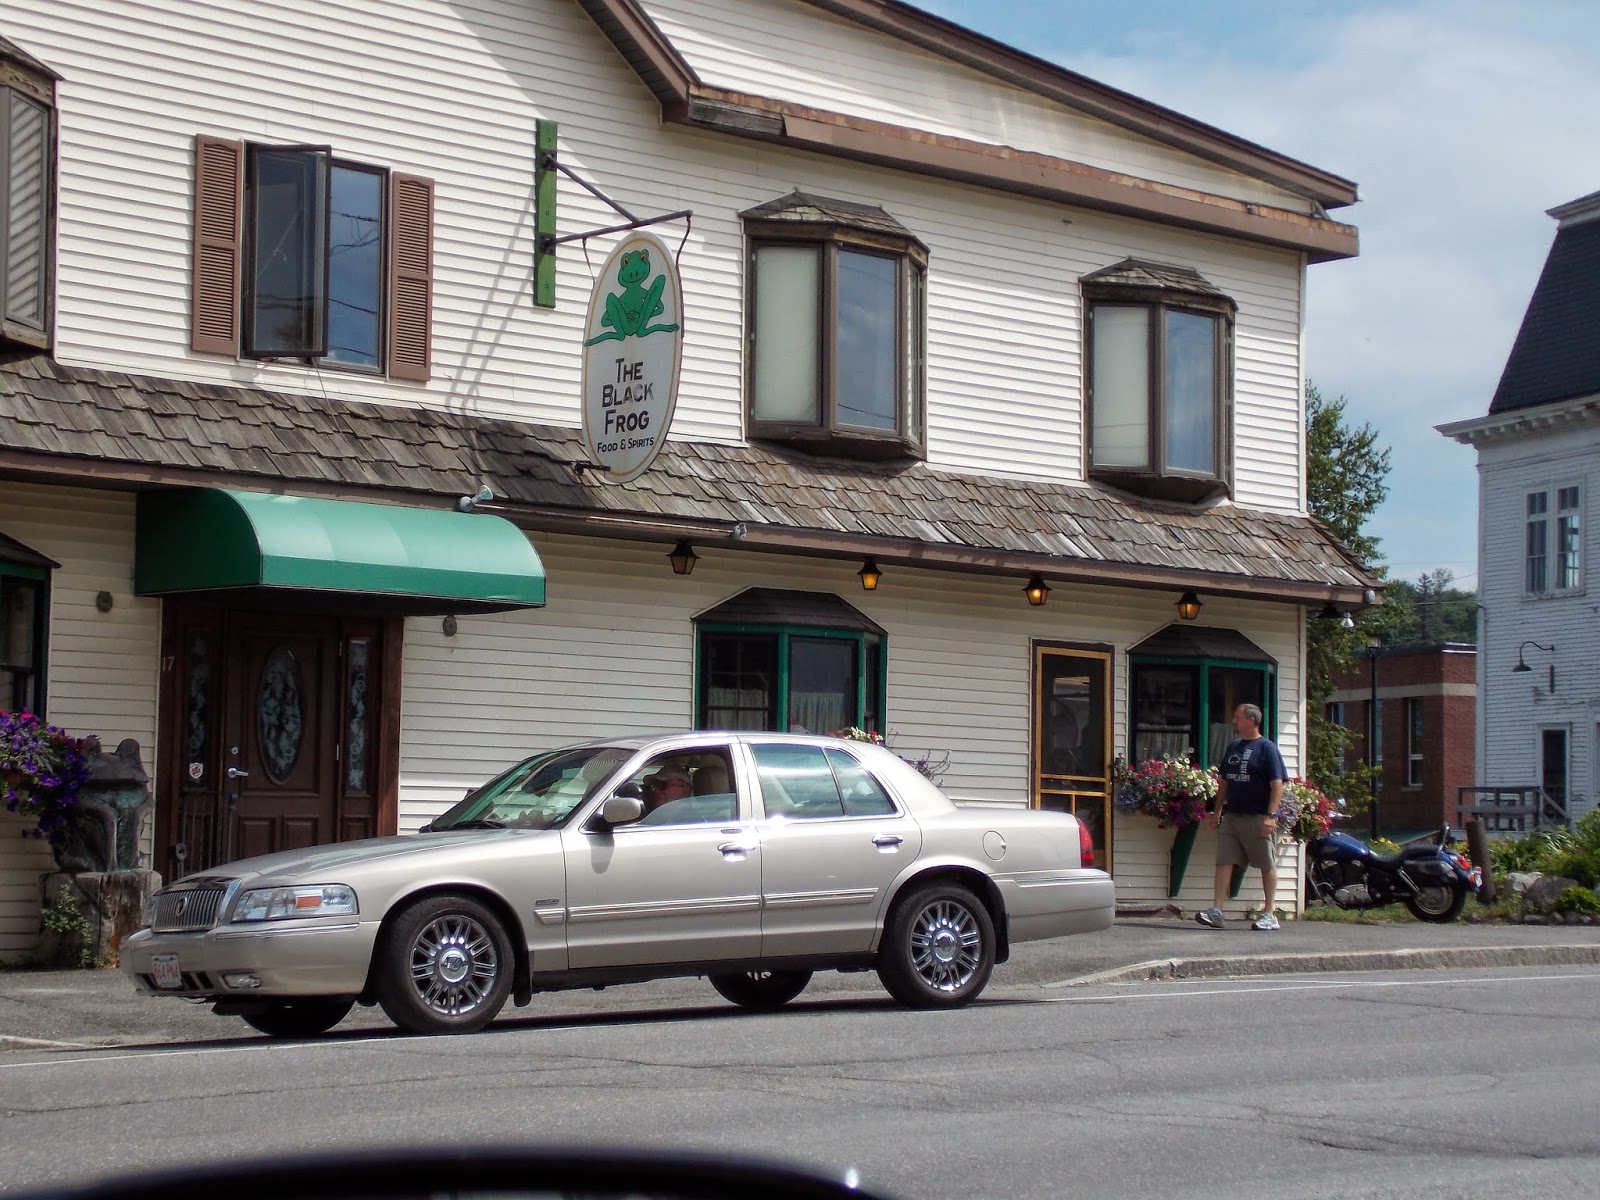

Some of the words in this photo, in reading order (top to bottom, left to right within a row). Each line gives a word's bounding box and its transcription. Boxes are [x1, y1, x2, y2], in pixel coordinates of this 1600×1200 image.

[615, 358, 644, 384] THE
[602, 382, 654, 408] BLACK
[604, 409, 650, 435] FROG
[597, 442, 618, 454] FOOD
[620, 438, 626, 450] &
[627, 437, 655, 450] SPIRITS
[161, 656, 176, 672] 17
